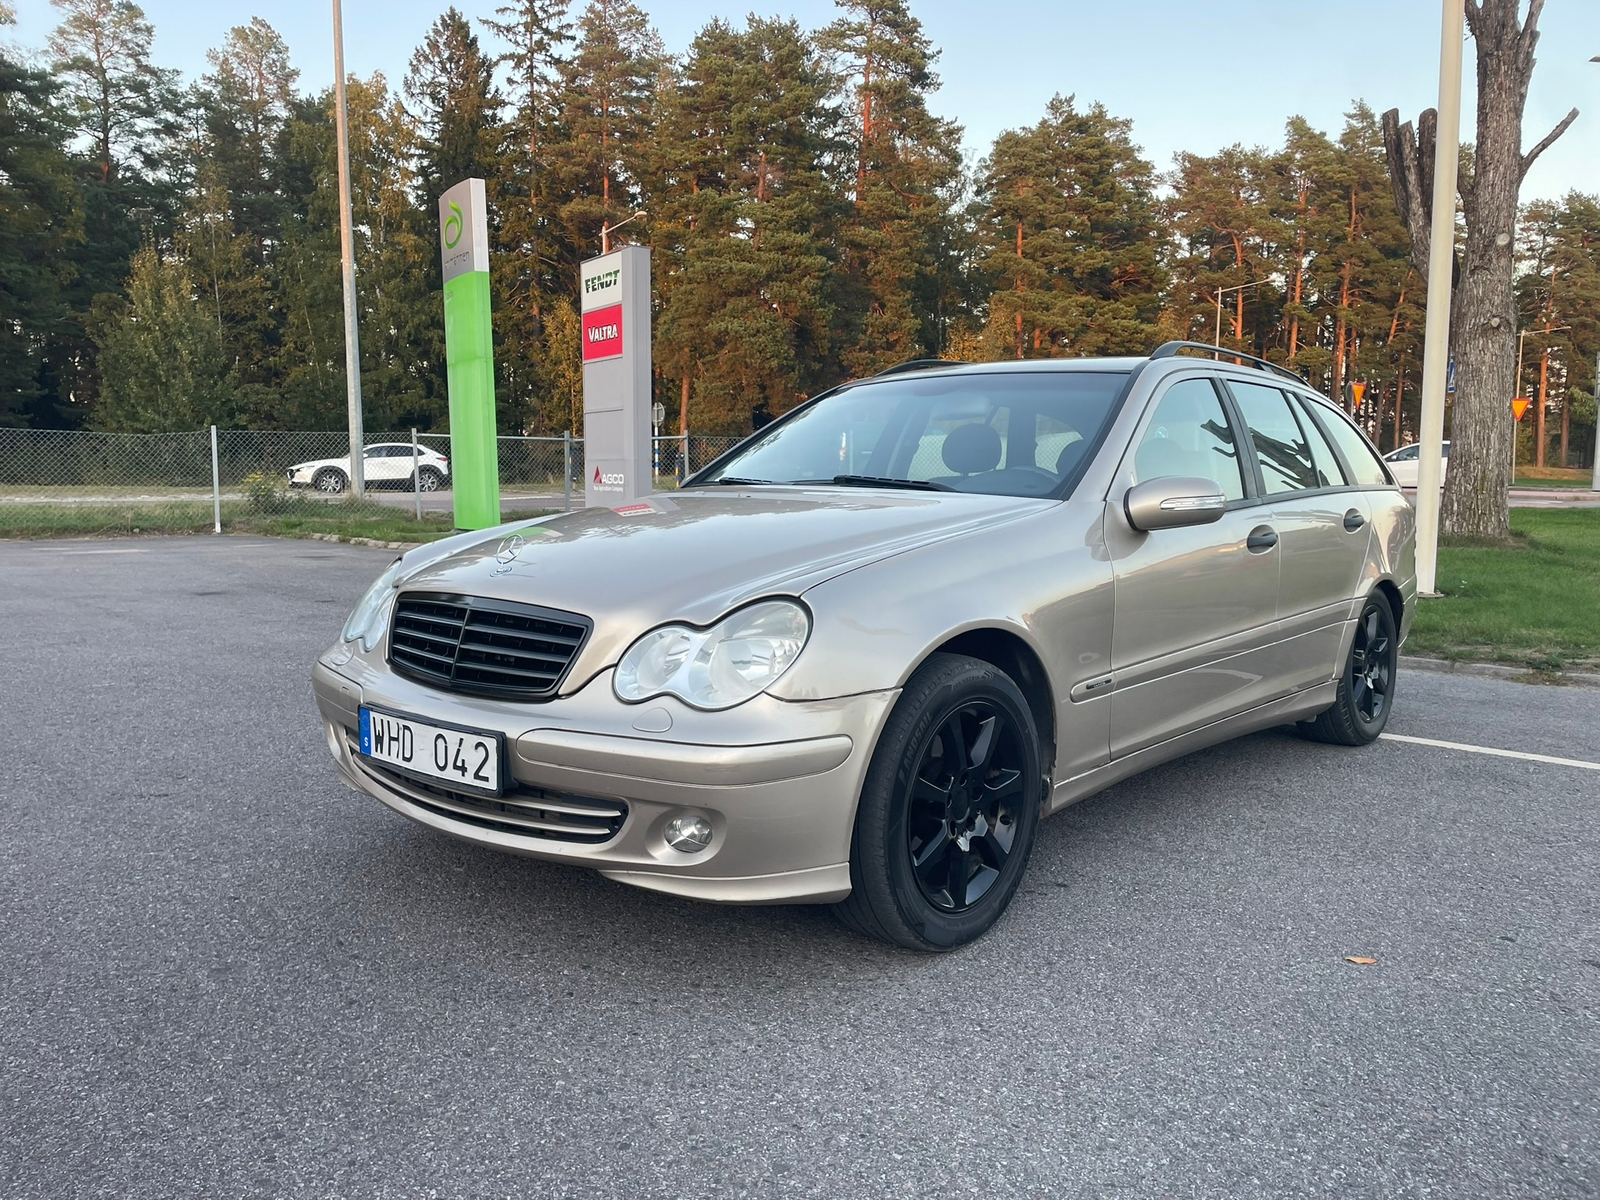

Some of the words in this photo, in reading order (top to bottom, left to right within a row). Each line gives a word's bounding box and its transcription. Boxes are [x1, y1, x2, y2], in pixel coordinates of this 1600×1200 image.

[584, 269, 620, 294] FENDT
[587, 323, 618, 344] VALTRA
[602, 474, 624, 484] AGCO
[363, 736, 369, 747] S
[372, 716, 414, 763] WHD
[434, 733, 490, 783] 042
[898, 711, 933, 788] LANDSAIL
